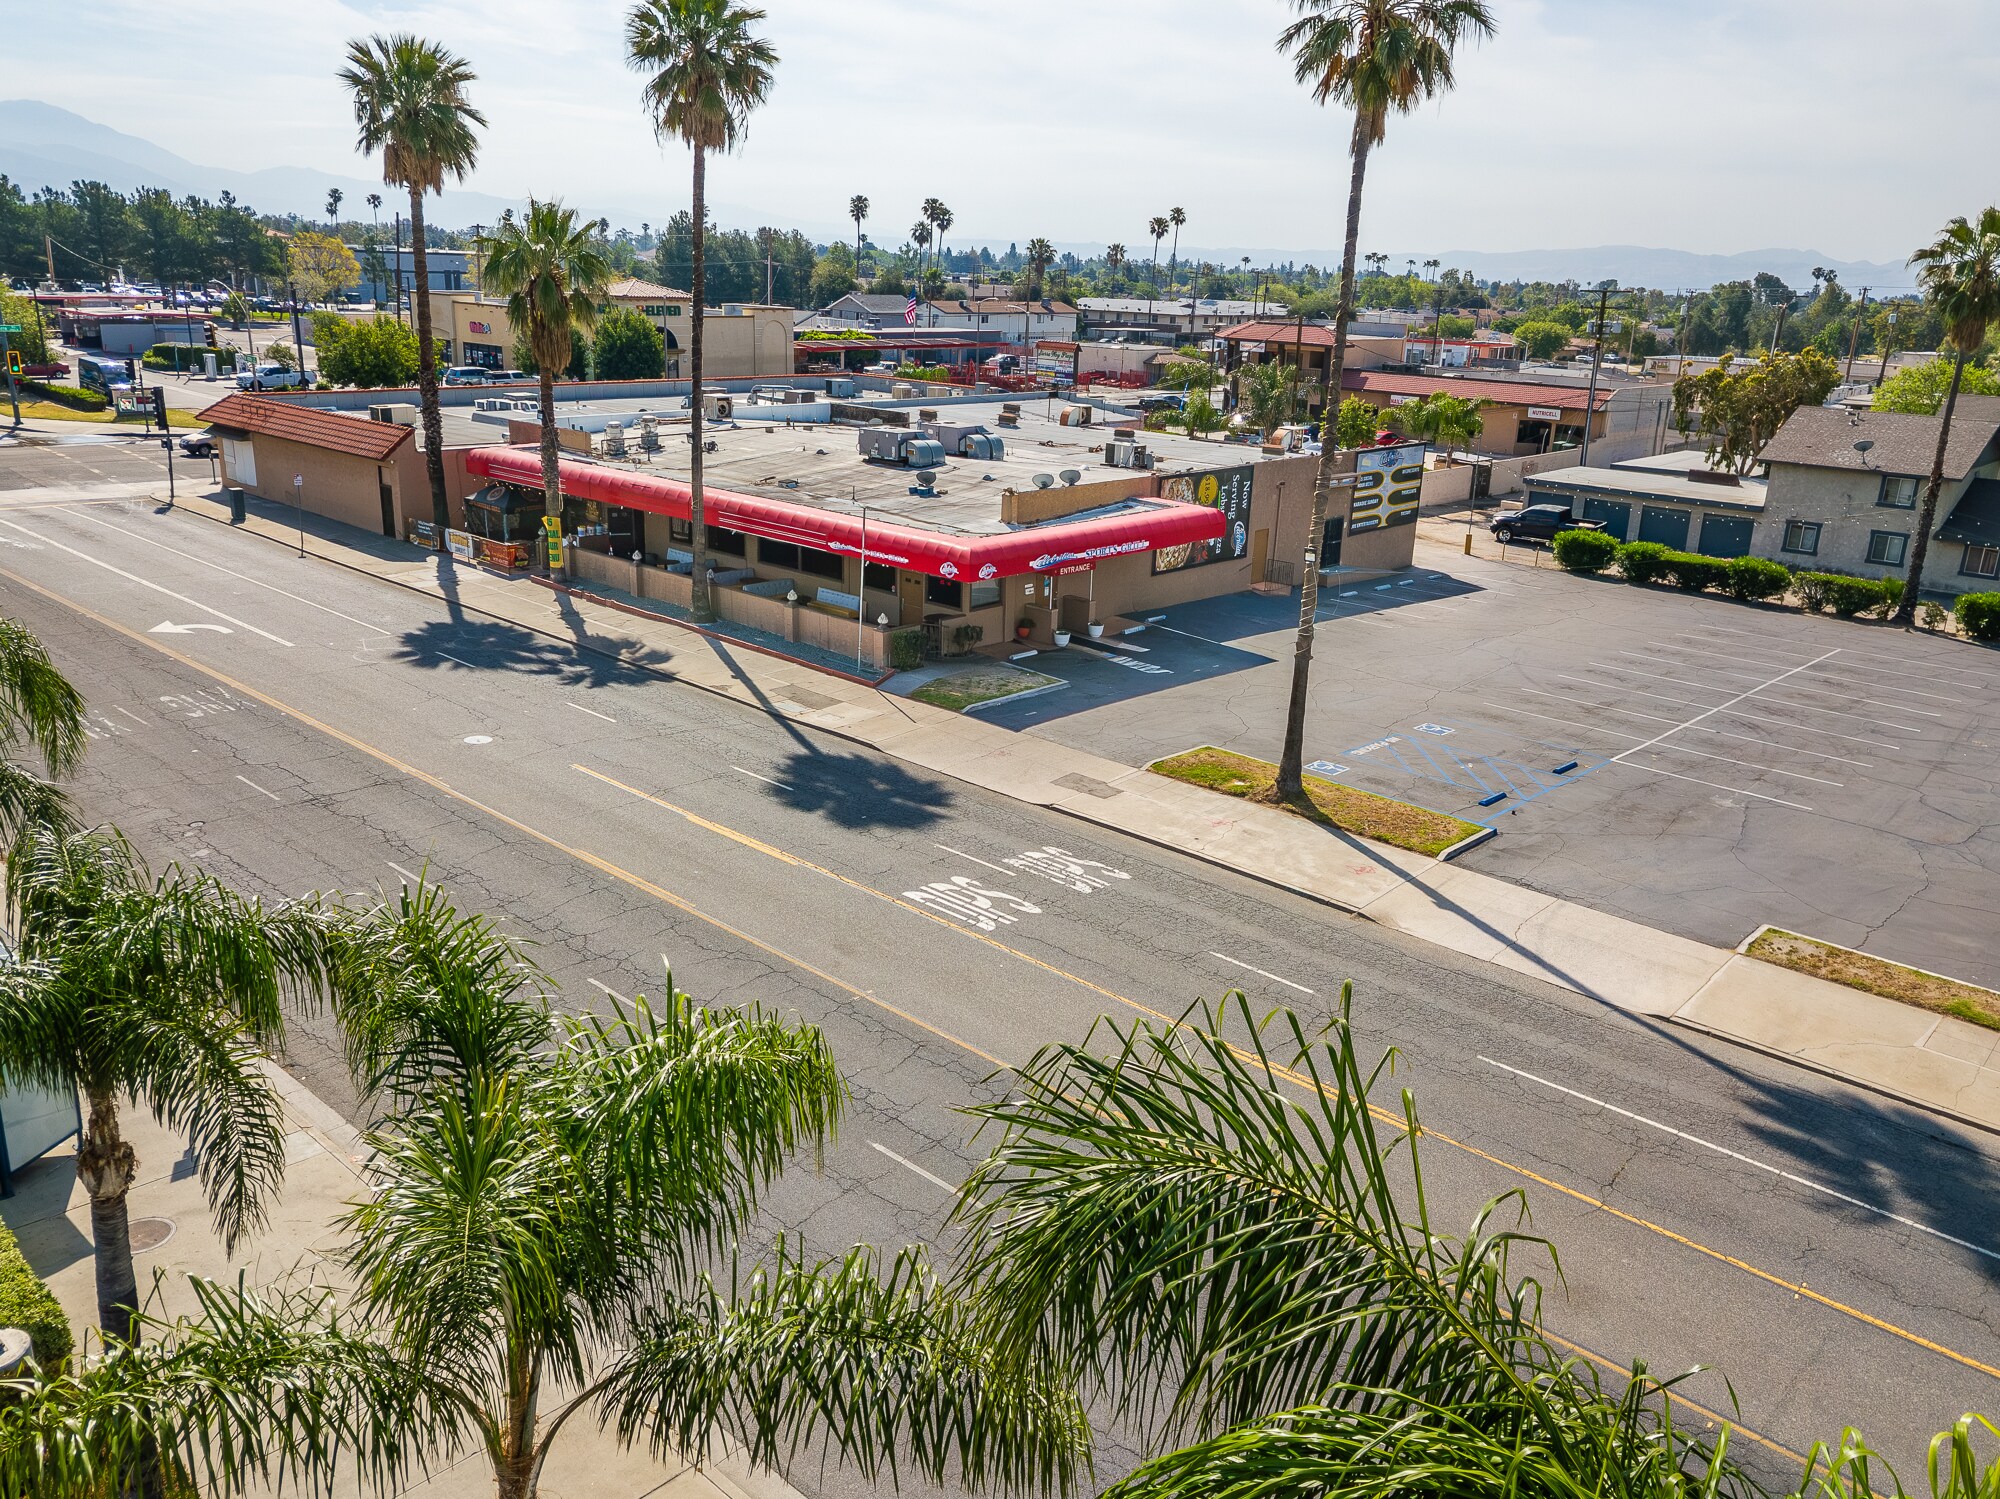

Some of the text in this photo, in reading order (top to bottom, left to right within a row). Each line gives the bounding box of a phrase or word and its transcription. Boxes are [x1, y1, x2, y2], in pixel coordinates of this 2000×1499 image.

[1532, 410, 1557, 418] NUTRICELL
[1228, 474, 1240, 520] Serving
[1241, 481, 1251, 509] Now
[1085, 545, 1118, 558] SPORTS
[1120, 541, 1147, 552] GRILL
[1060, 563, 1091, 575] ENTRANCE
